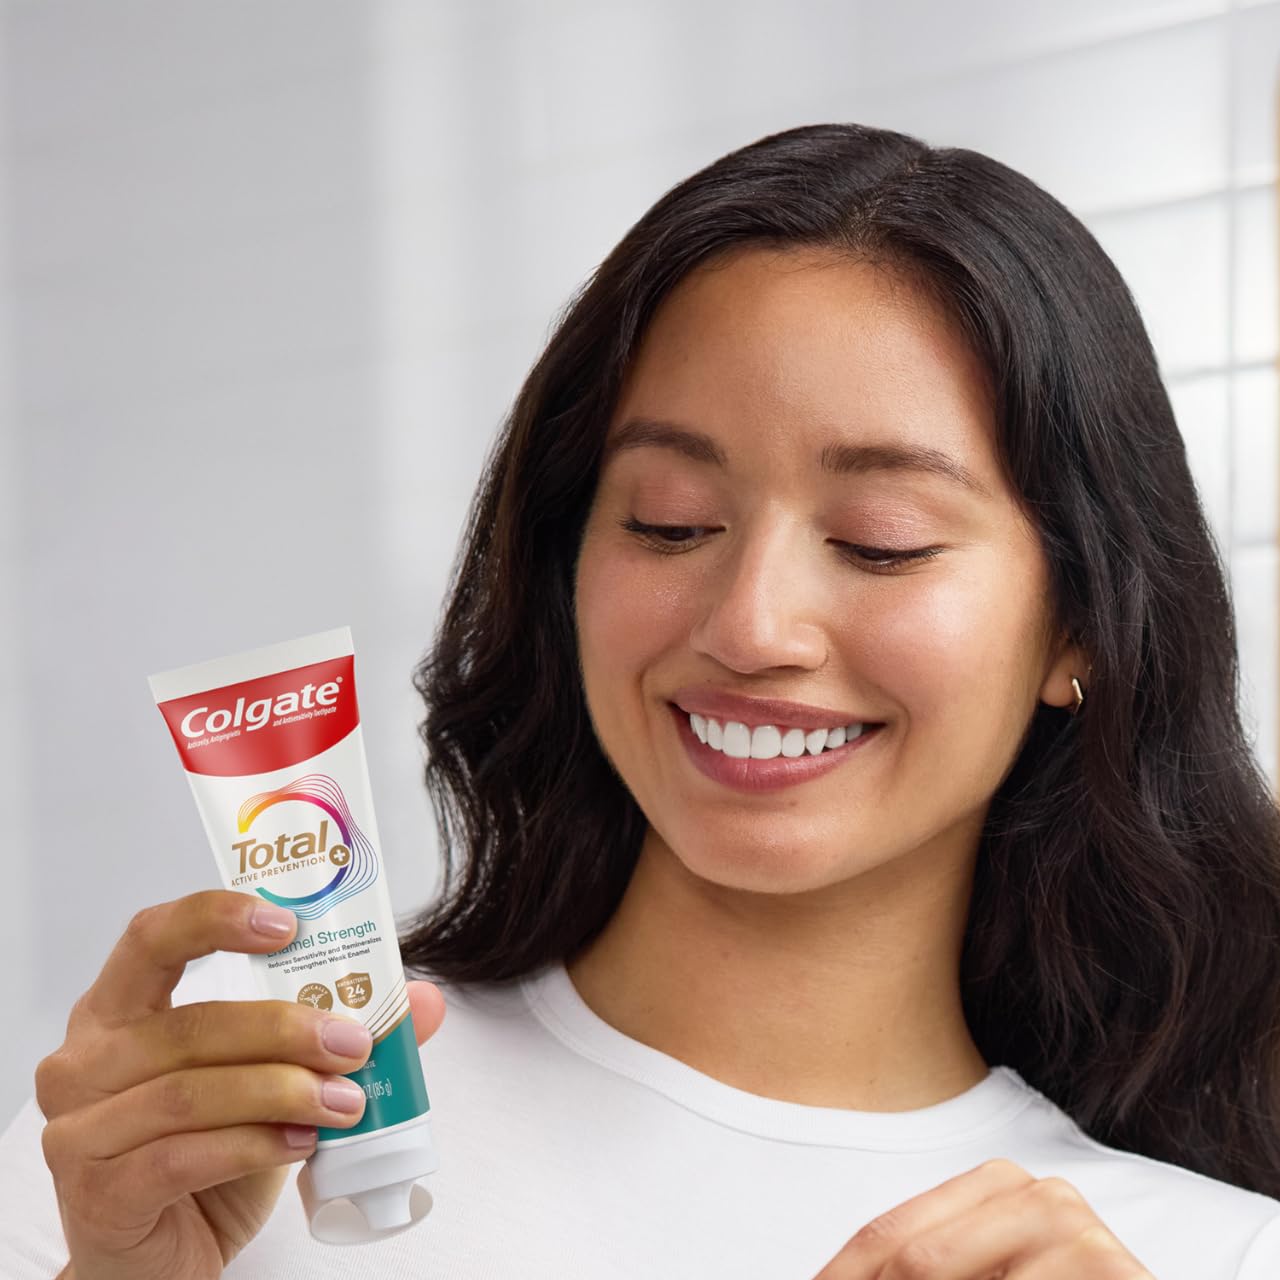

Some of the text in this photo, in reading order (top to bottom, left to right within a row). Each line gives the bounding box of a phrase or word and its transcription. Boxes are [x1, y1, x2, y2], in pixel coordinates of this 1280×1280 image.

[231, 855, 326, 887] ACTIVE PREVENTION
[267, 920, 377, 958] amel Strength
[267, 936, 383, 969] Reduces Sensitivity and Remineralizes
[291, 959, 328, 973] Strengthen
[347, 947, 371, 959] Enamel
[347, 984, 365, 998] 24
